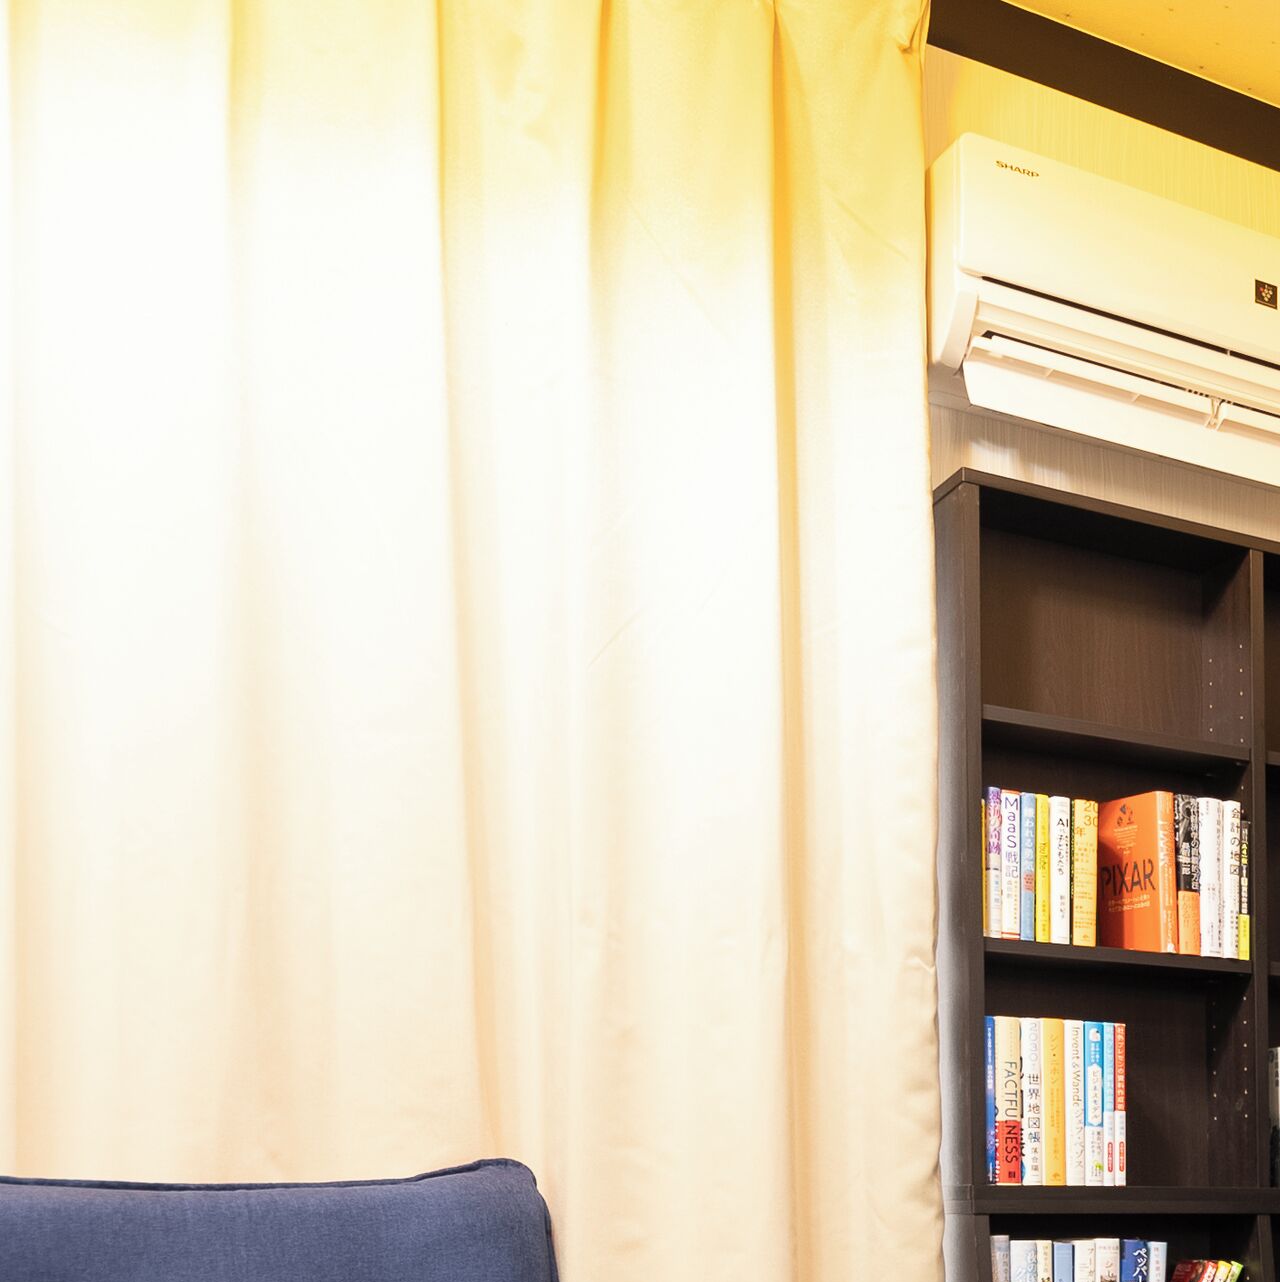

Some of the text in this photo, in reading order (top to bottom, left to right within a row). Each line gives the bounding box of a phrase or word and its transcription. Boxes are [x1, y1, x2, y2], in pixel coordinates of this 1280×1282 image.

[995, 160, 1040, 178] SHARP
[1057, 818, 1069, 836] AI
[1101, 858, 1156, 898] PIXAR
[1071, 1026, 1080, 1059] Invent
